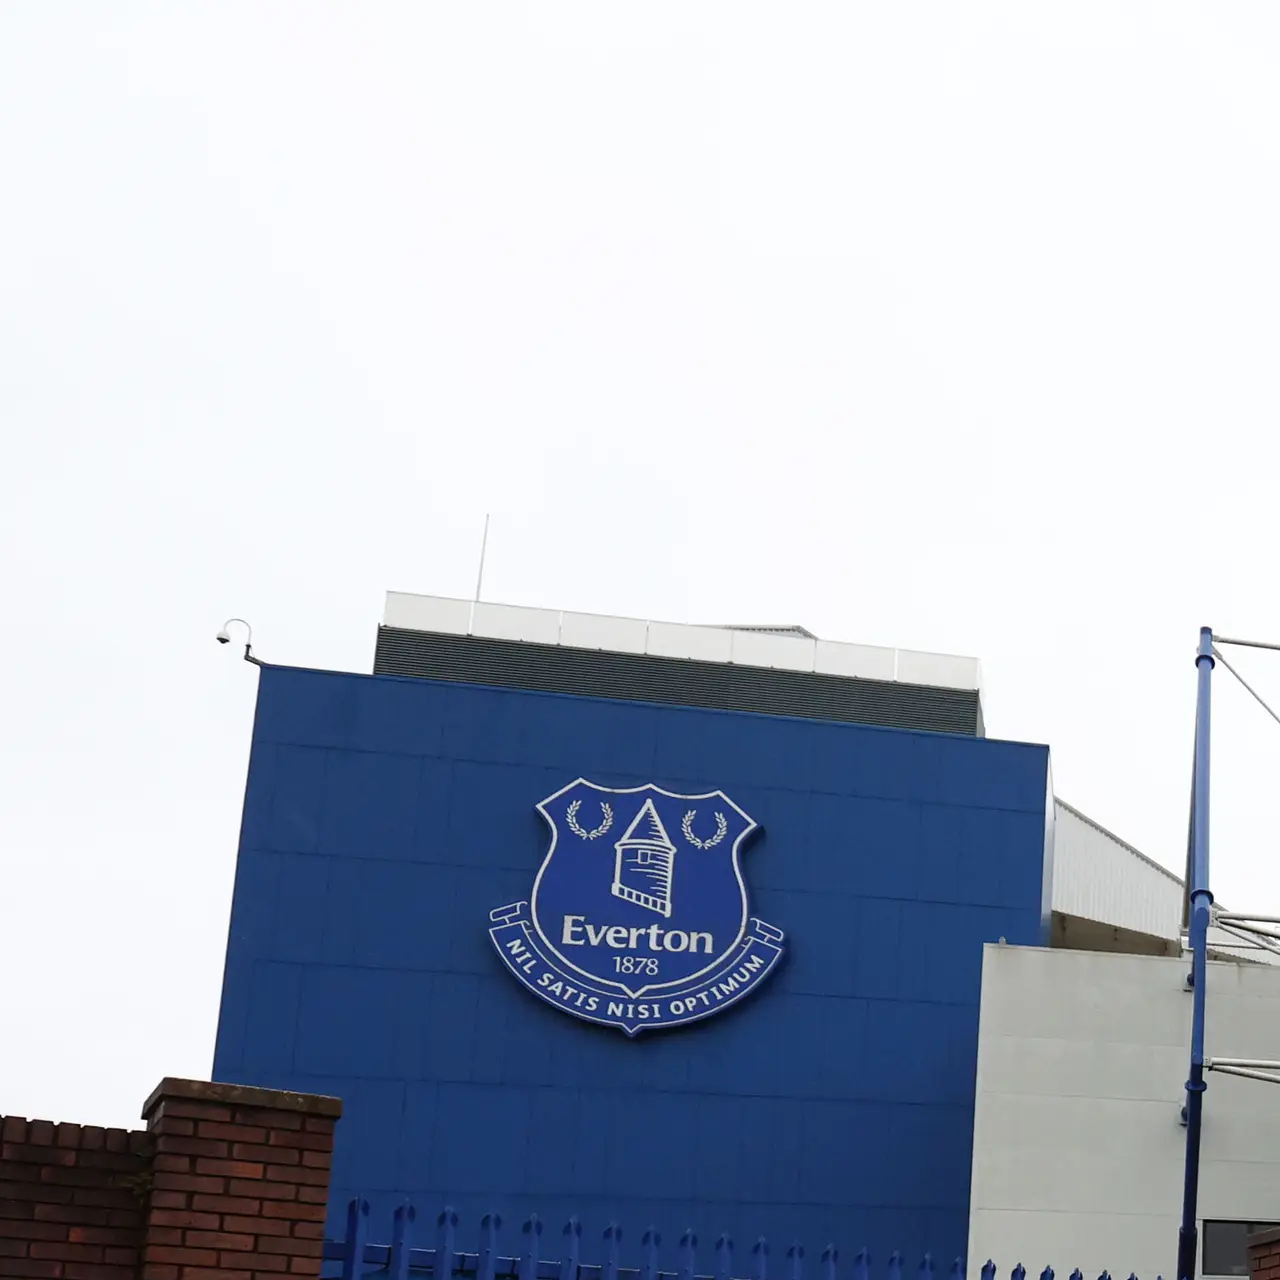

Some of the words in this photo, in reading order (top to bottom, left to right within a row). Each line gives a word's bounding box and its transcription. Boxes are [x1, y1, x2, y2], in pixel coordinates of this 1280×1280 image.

[562, 915, 713, 953] Everton
[506, 939, 533, 974] NIL
[537, 972, 599, 1012] SATIS
[607, 1003, 661, 1018] NISI
[669, 955, 765, 1015] OPTIMUM
[612, 956, 658, 976] 1878
